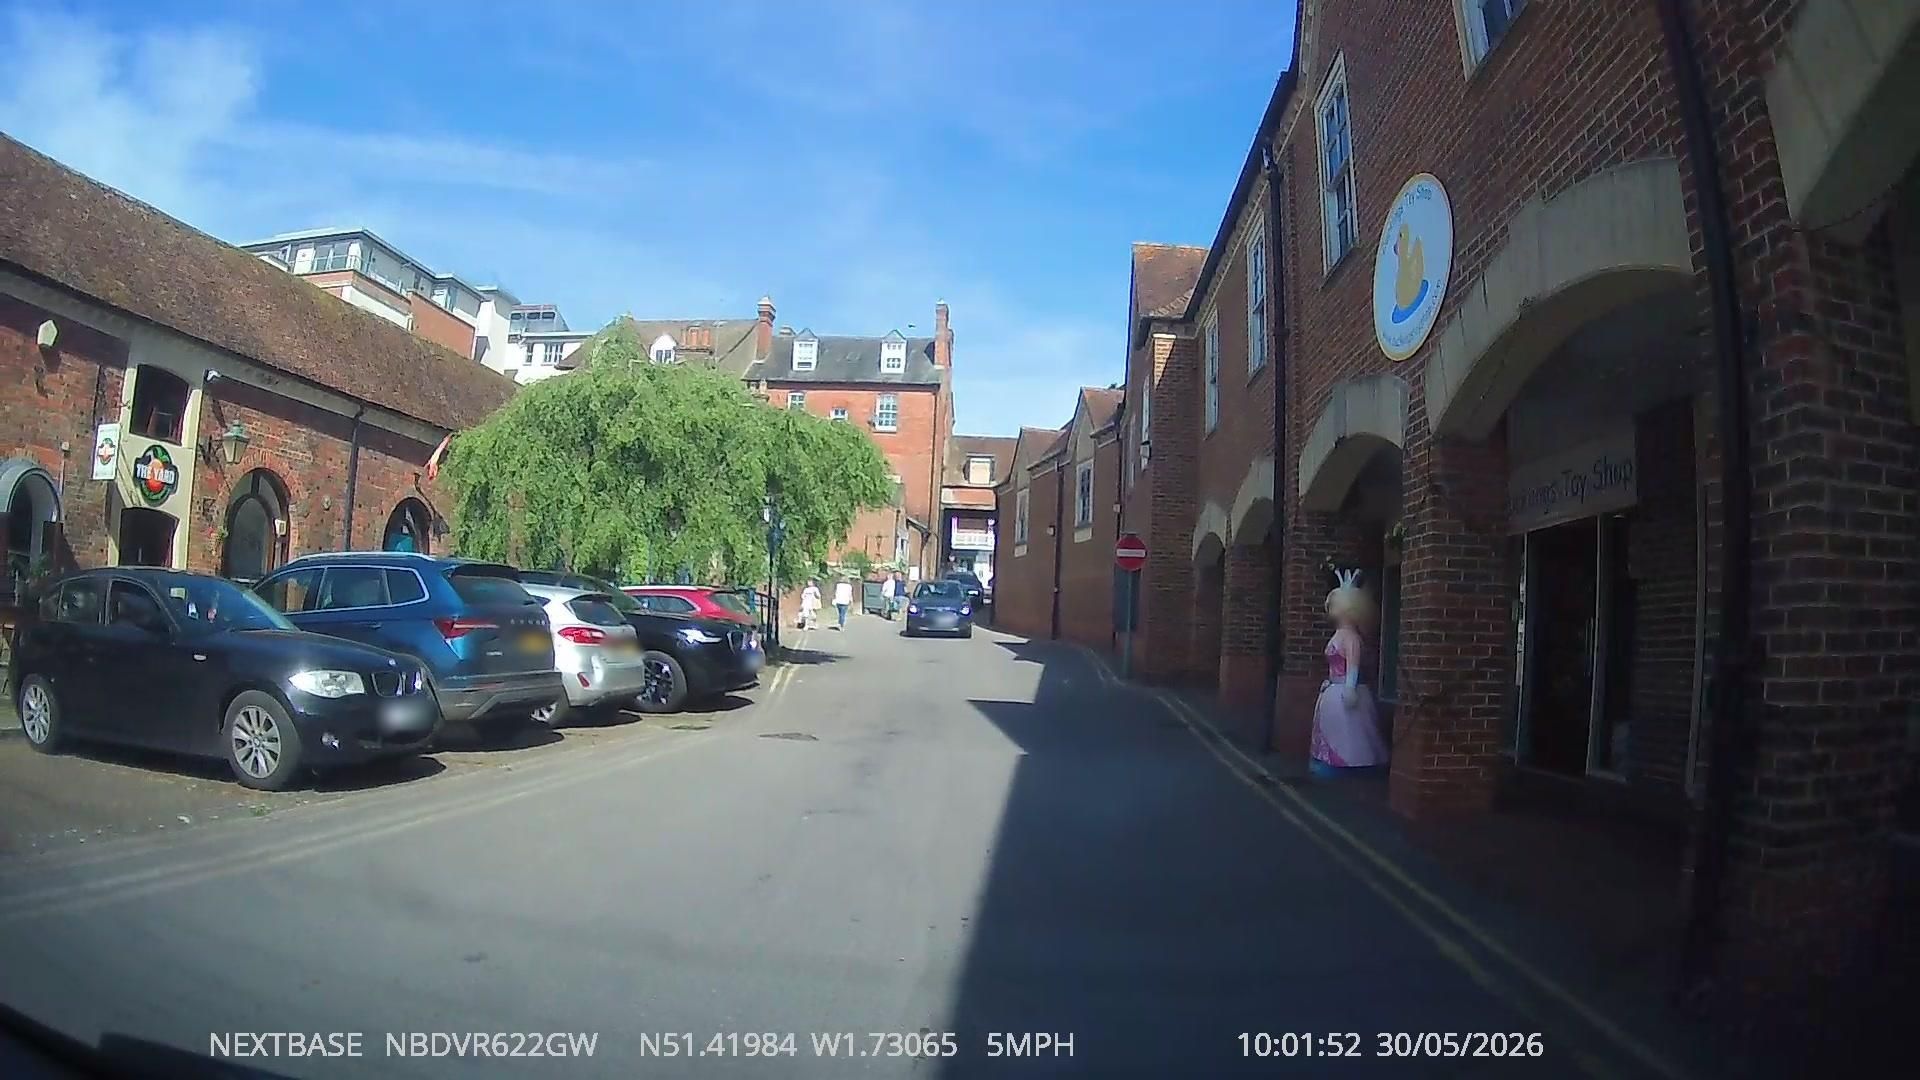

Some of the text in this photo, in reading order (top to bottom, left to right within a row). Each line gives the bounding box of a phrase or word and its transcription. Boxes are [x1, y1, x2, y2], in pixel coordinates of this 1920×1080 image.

[136, 463, 175, 485] THE YARD
[1562, 468, 1587, 504] Toy
[1593, 455, 1634, 491] Shop
